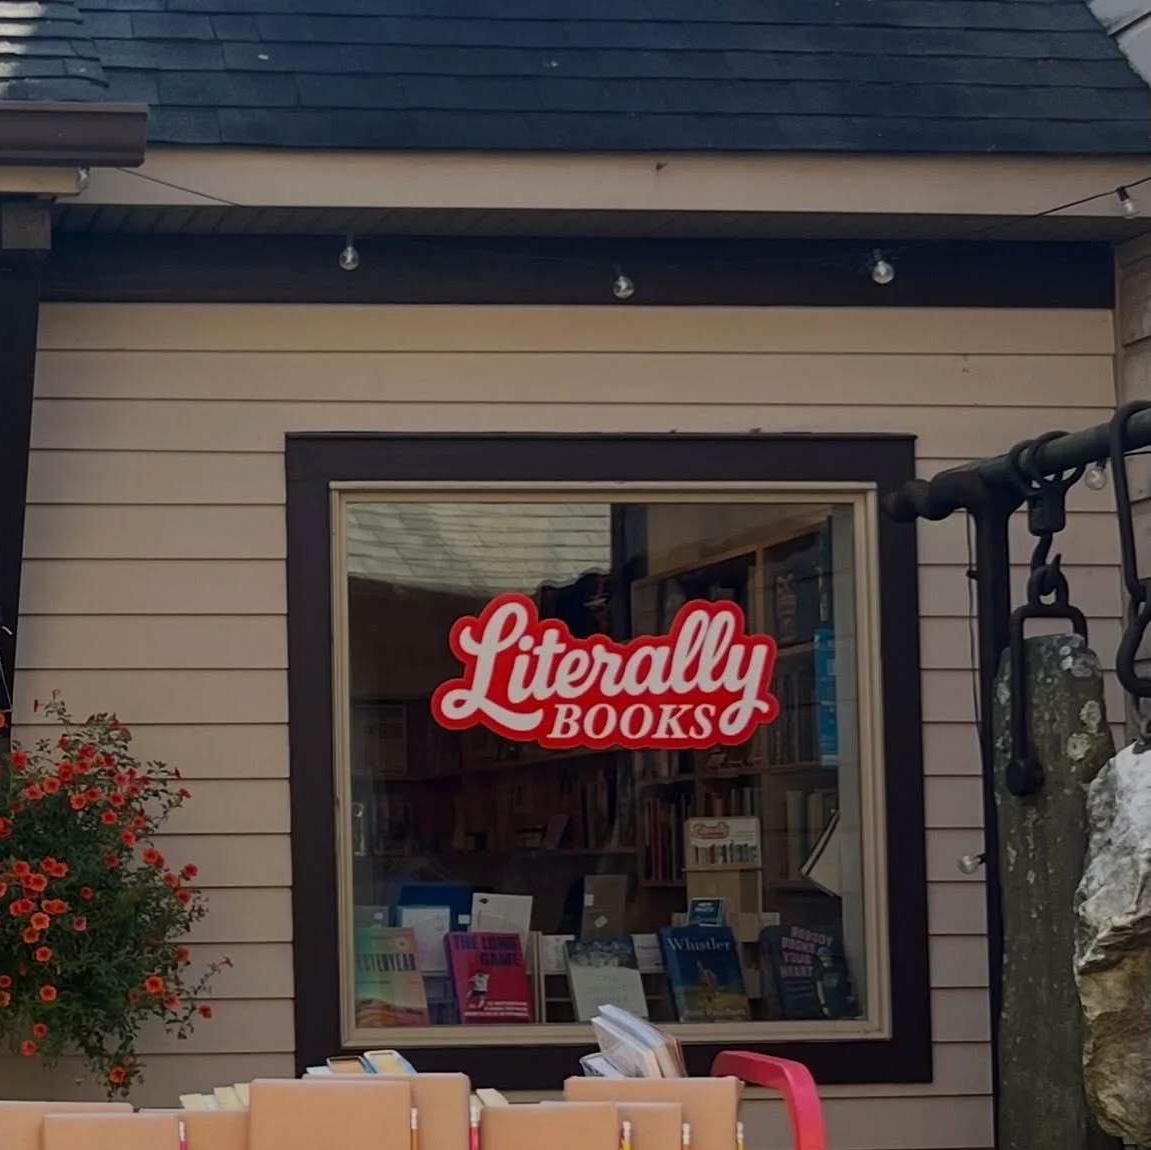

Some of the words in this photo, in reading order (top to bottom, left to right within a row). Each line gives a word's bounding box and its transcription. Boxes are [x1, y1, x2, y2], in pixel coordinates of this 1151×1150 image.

[441, 602, 769, 736] Literally
[547, 703, 716, 739] BOOKS
[667, 937, 731, 952] Whistler
